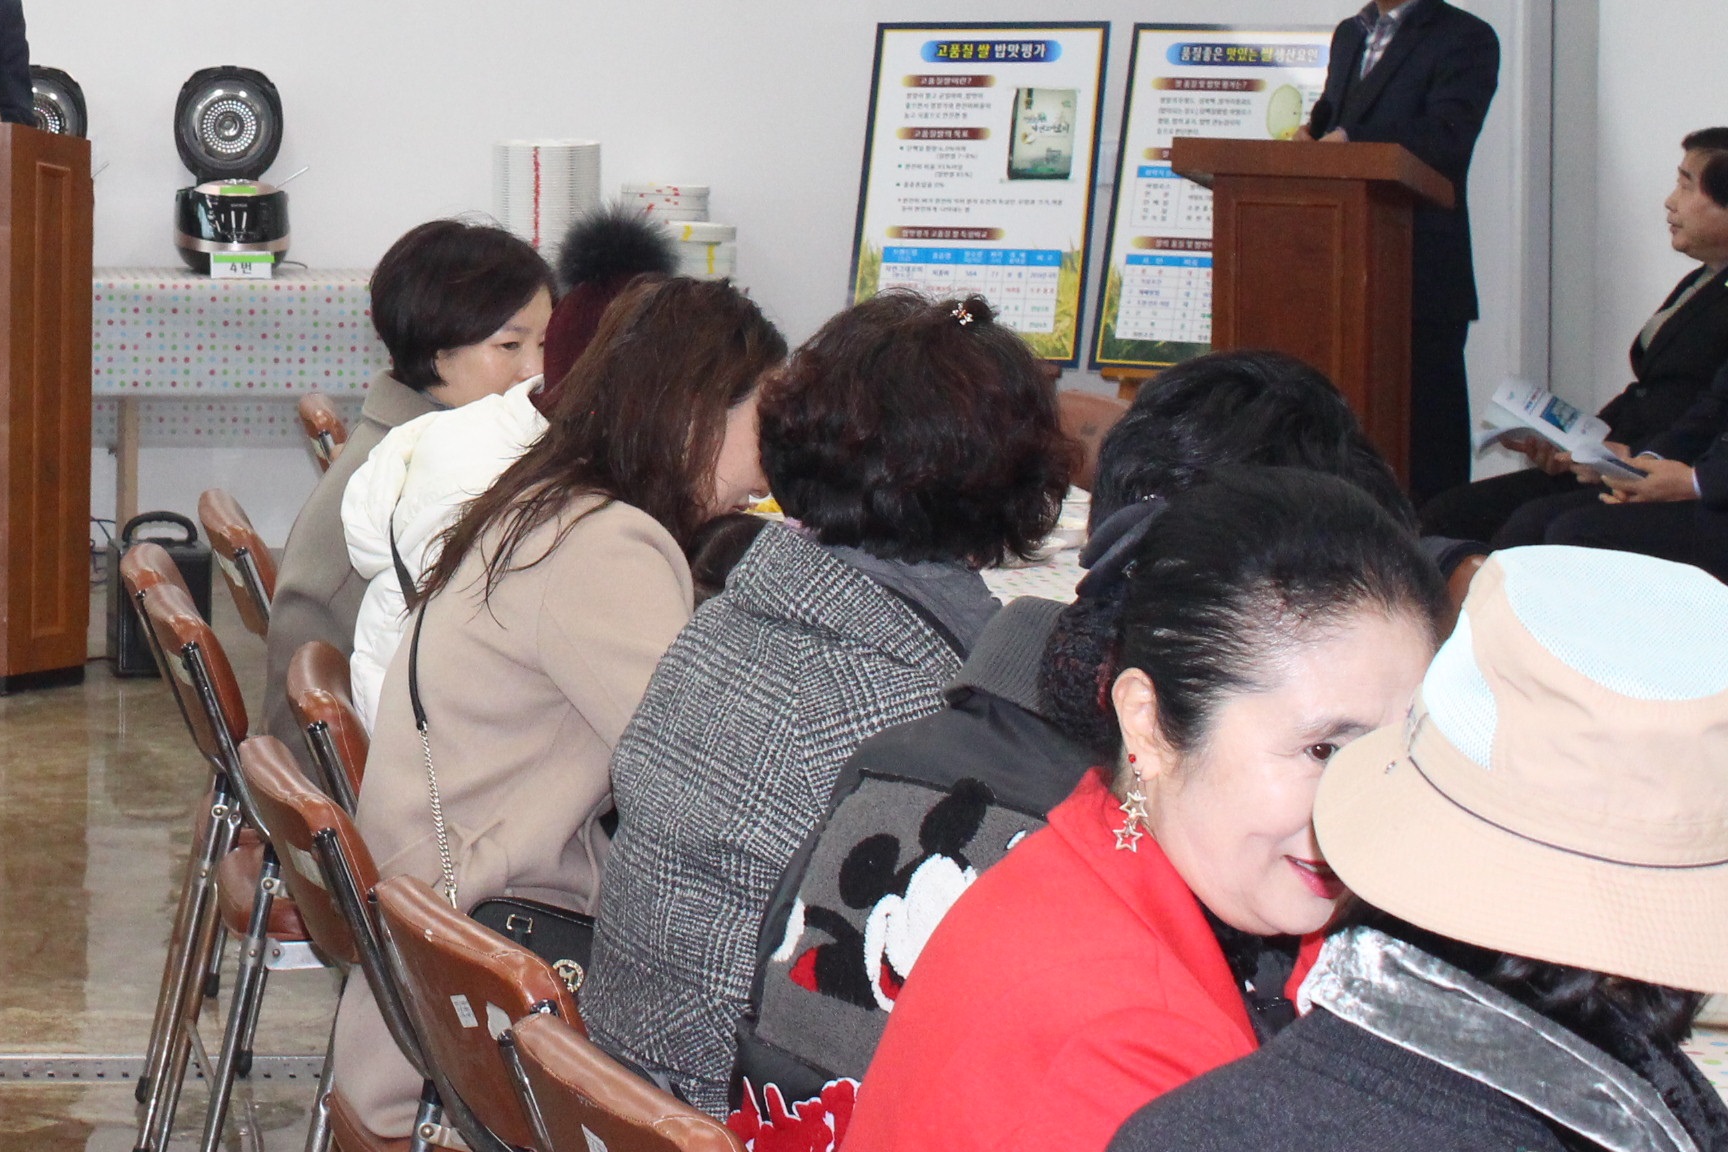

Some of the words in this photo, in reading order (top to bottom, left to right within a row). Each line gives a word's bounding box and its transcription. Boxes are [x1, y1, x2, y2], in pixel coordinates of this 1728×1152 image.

[936, 43, 973, 59] 고품질
[977, 43, 991, 59] 쌀
[994, 43, 1047, 59] 밥맛평가
[1225, 47, 1260, 62] 맛있는
